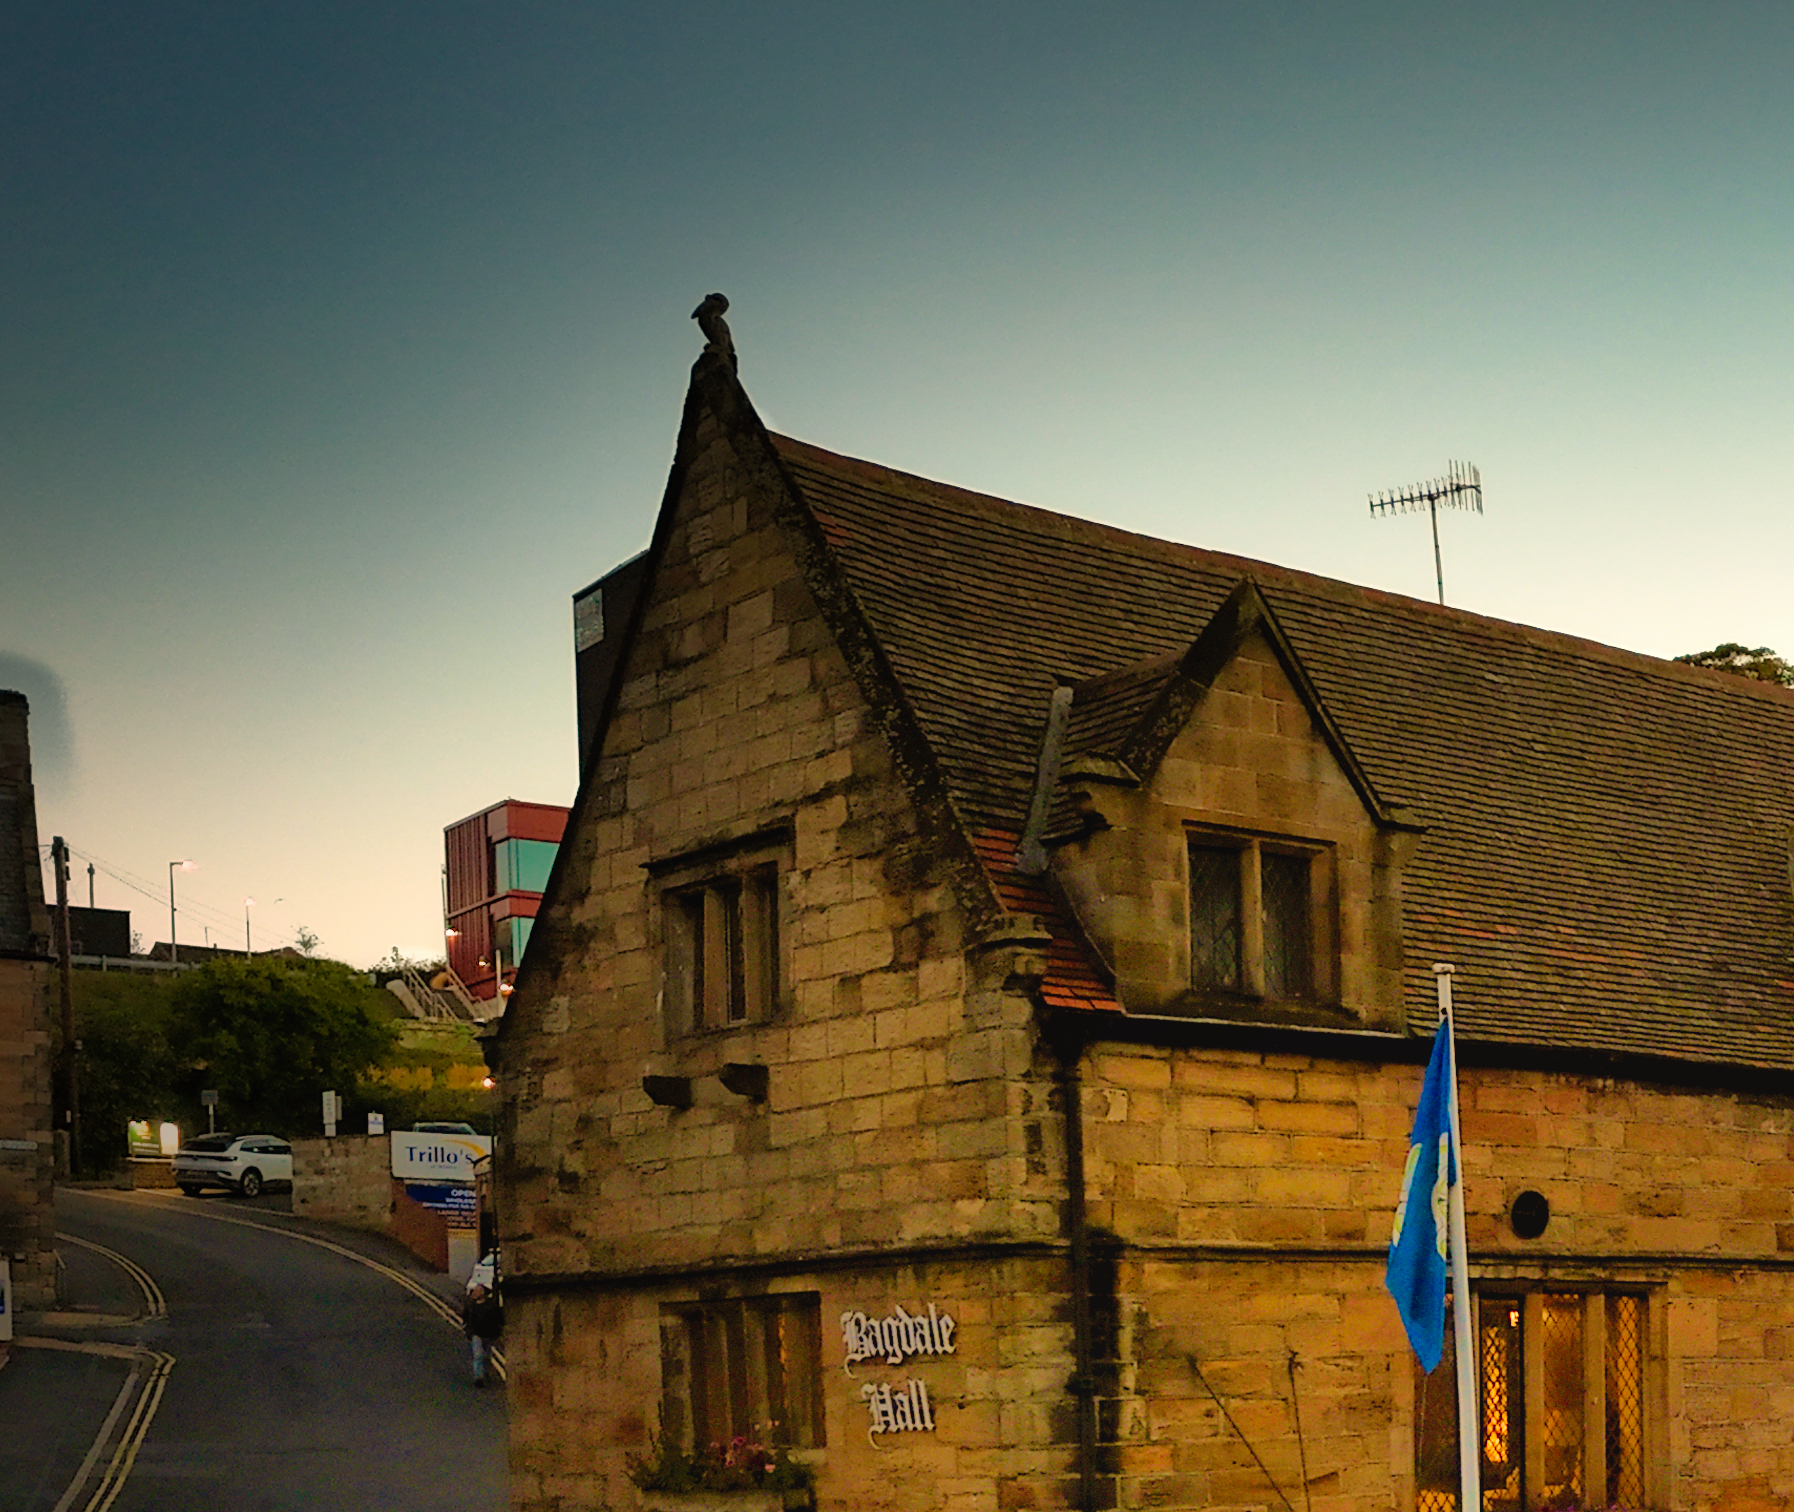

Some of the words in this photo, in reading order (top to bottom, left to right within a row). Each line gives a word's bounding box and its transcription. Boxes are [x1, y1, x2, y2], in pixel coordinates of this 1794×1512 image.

[405, 1146, 474, 1164] Trillo's
[840, 1302, 957, 1379] Bagdale
[861, 1378, 937, 1450] Hall
